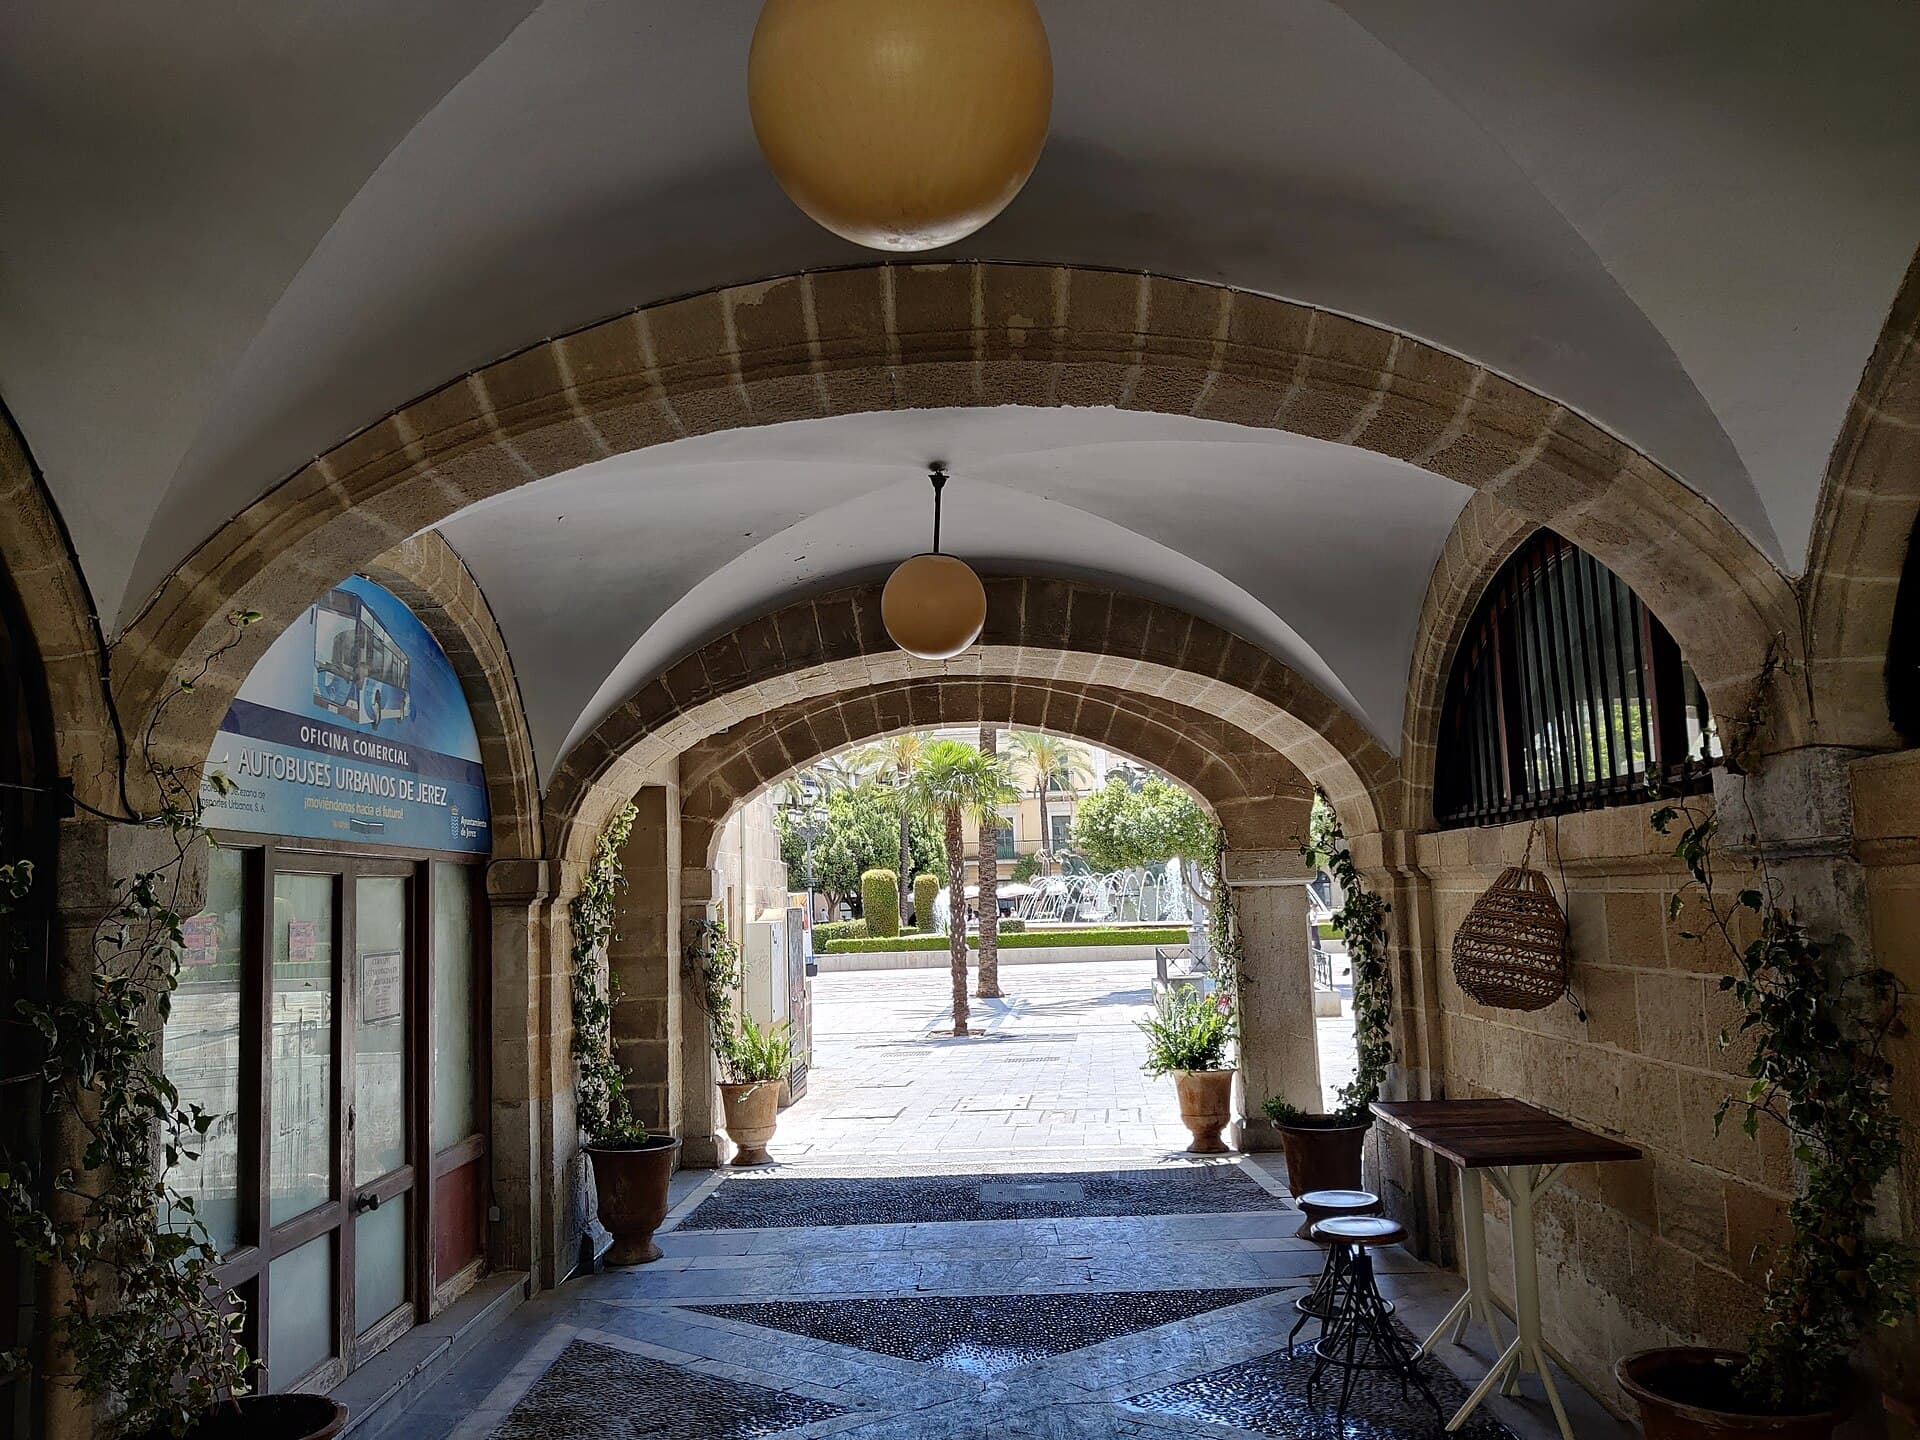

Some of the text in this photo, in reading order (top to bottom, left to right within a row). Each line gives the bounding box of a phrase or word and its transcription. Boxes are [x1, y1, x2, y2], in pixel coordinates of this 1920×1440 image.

[300, 726, 409, 766] OFICINA COMERCIAL
[238, 748, 447, 806] AUTOBUSES URBANOS DE JEREZ
[356, 801, 374, 816] hacia
[375, 805, 382, 816] el
